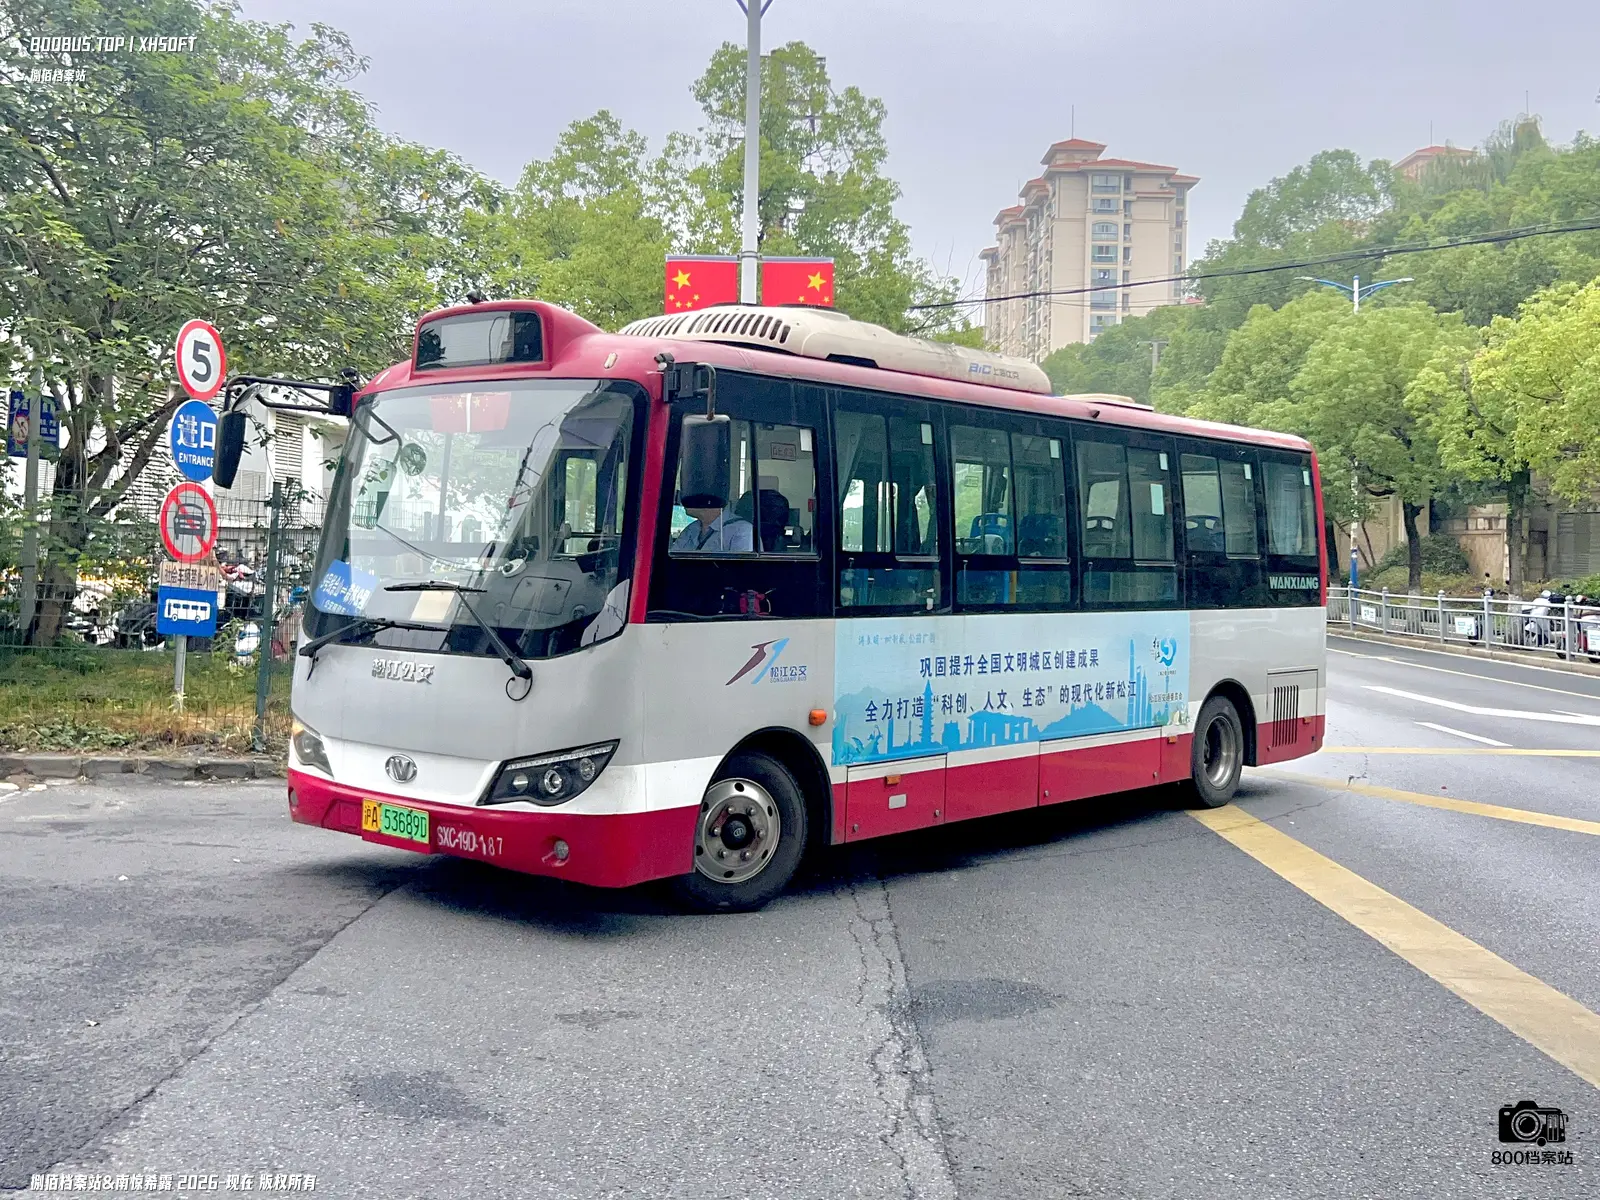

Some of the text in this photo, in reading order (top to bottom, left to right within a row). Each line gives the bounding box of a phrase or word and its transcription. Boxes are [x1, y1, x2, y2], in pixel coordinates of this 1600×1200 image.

[191, 339, 212, 383] 5
[176, 413, 217, 451] 进口
[178, 452, 214, 468] ENTRANCE
[1269, 576, 1319, 590] WANXIANG
[371, 658, 436, 685] 松江公交
[770, 665, 807, 678] 松江公交
[919, 648, 1100, 678] 巩固提升全国文明城区创建成果
